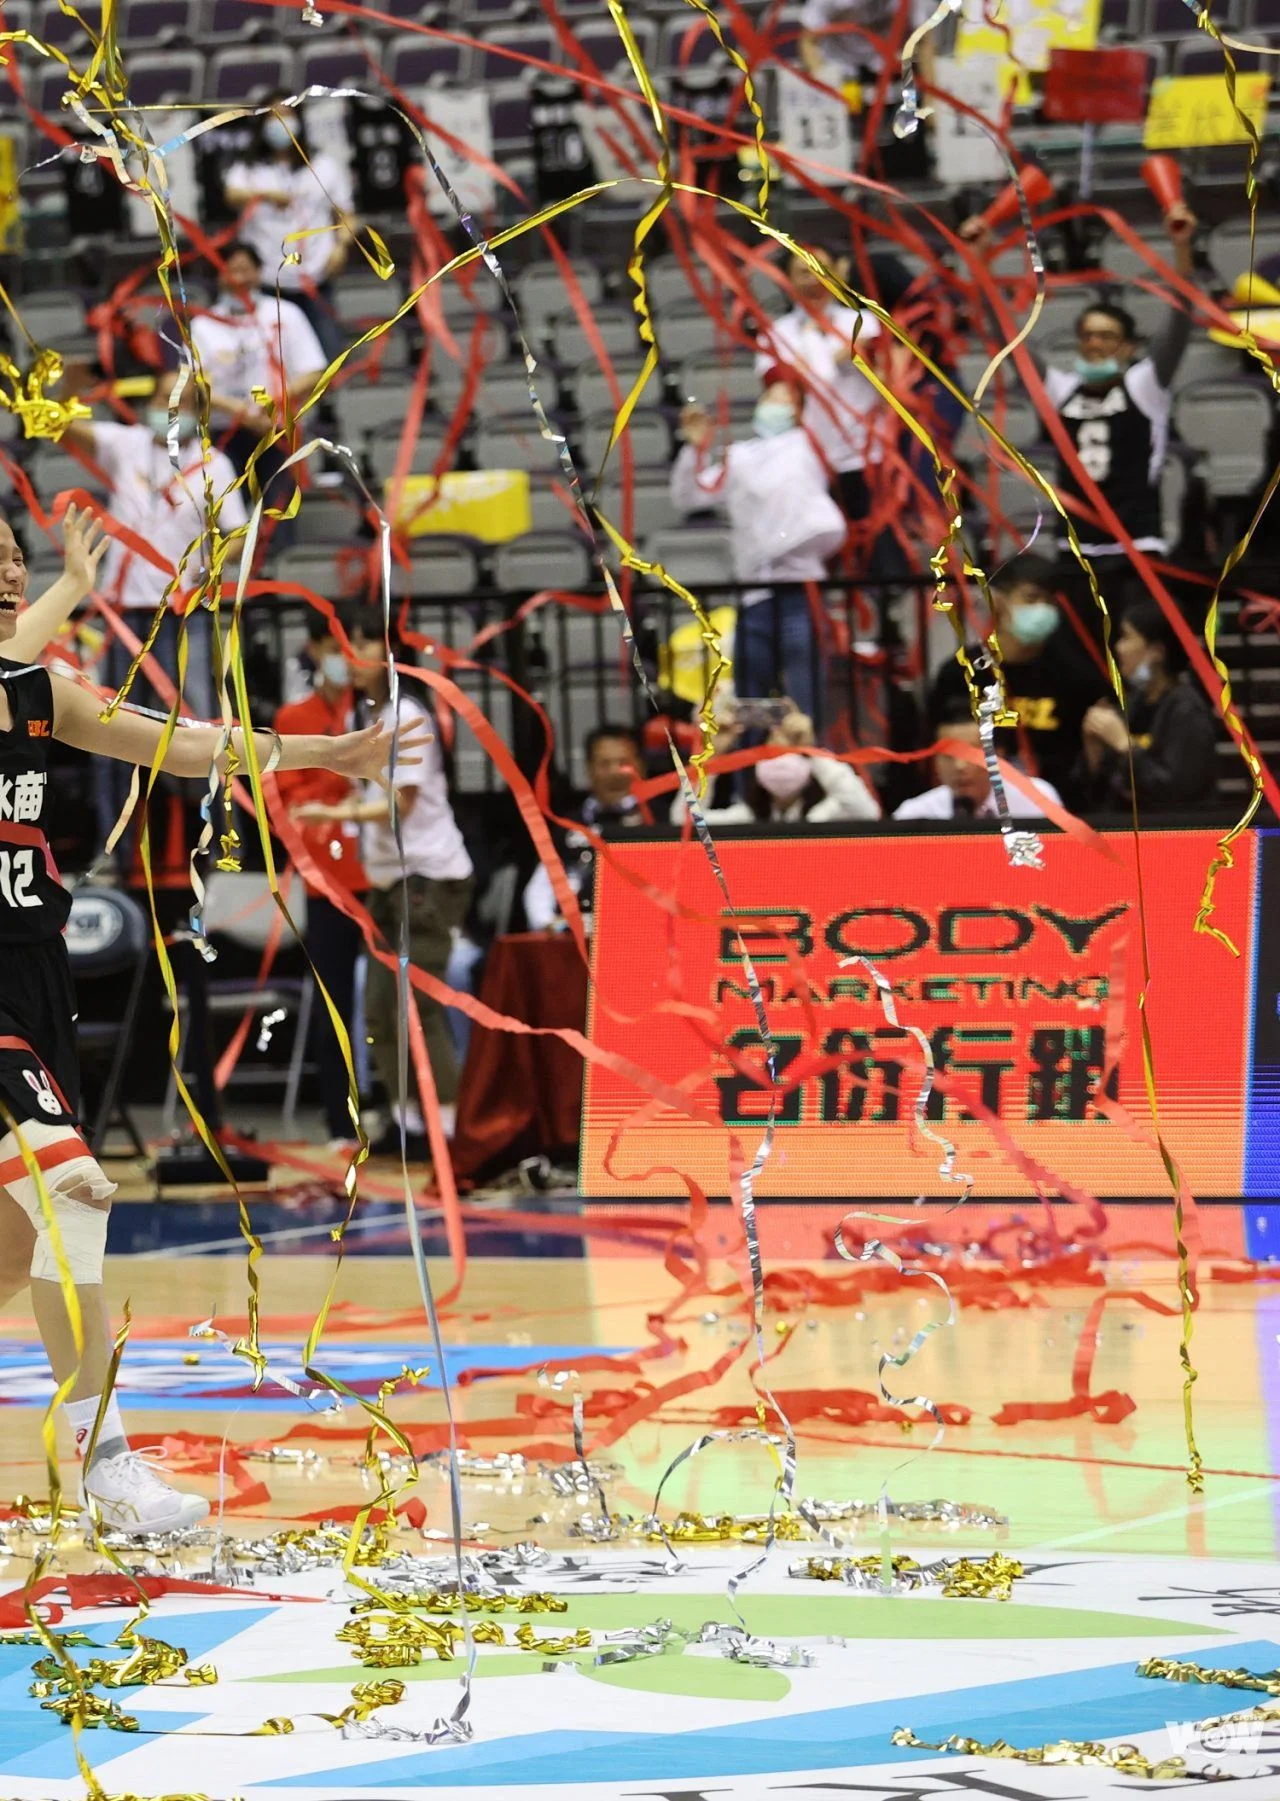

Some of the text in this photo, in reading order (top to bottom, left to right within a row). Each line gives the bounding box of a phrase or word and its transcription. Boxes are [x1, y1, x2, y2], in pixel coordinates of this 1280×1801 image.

[0, 849, 44, 908] 12
[719, 903, 1131, 963] BODY
[717, 974, 1113, 1003] MARKETING
